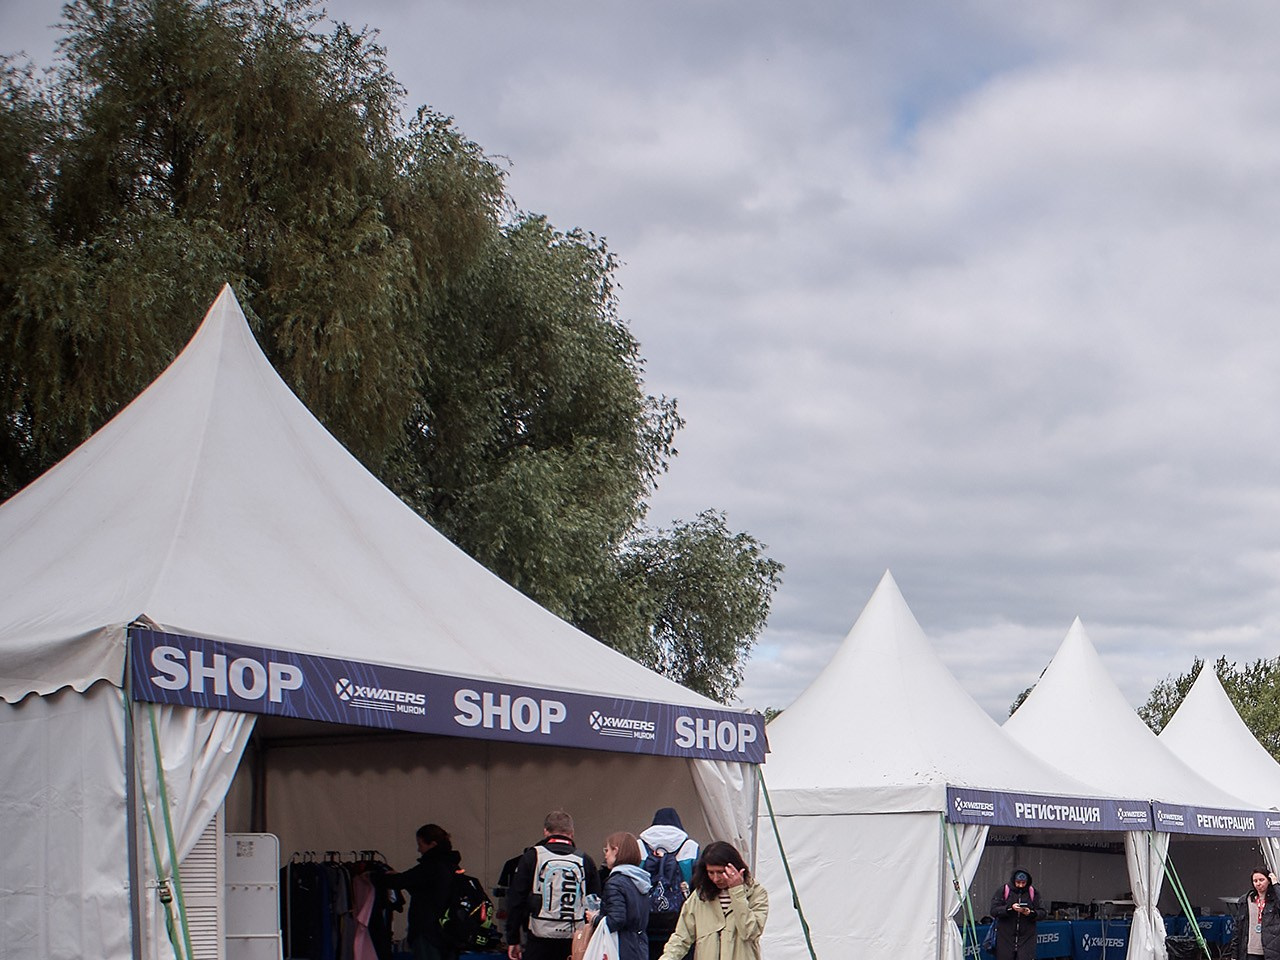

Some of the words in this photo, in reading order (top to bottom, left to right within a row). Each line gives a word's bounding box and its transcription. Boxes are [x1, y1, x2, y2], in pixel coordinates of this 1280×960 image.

[150, 646, 303, 703] SHOP
[396, 704, 426, 715] MUROM
[453, 688, 567, 734] SHOP
[675, 716, 757, 753] SHOP
[1014, 802, 1100, 824] РЕГИСТРАЦИЯ
[1197, 814, 1255, 831] РЕГИСТРАЦИЯ
